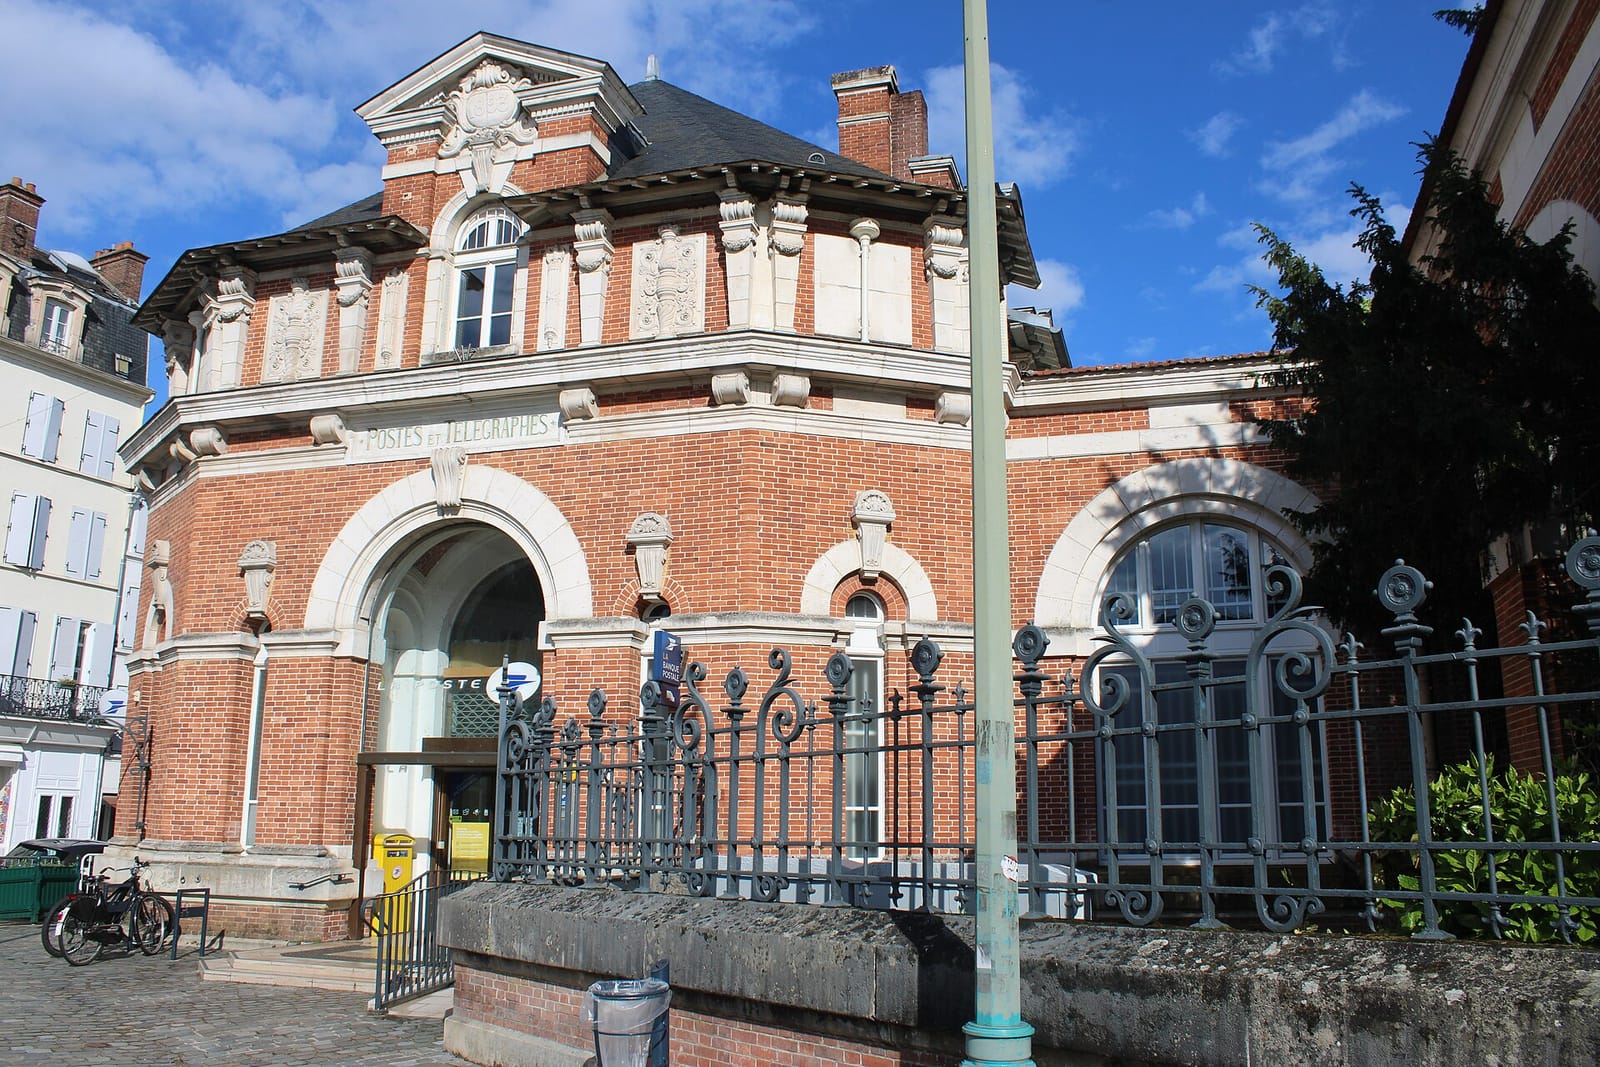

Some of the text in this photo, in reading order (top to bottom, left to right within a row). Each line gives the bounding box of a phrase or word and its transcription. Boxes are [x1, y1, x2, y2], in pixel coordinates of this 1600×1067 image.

[366, 426, 423, 450] POSTES
[427, 433, 441, 447] ET
[662, 652, 669, 660] LA
[662, 661, 680, 673] BANQUE
[662, 670, 680, 681] POSTALE
